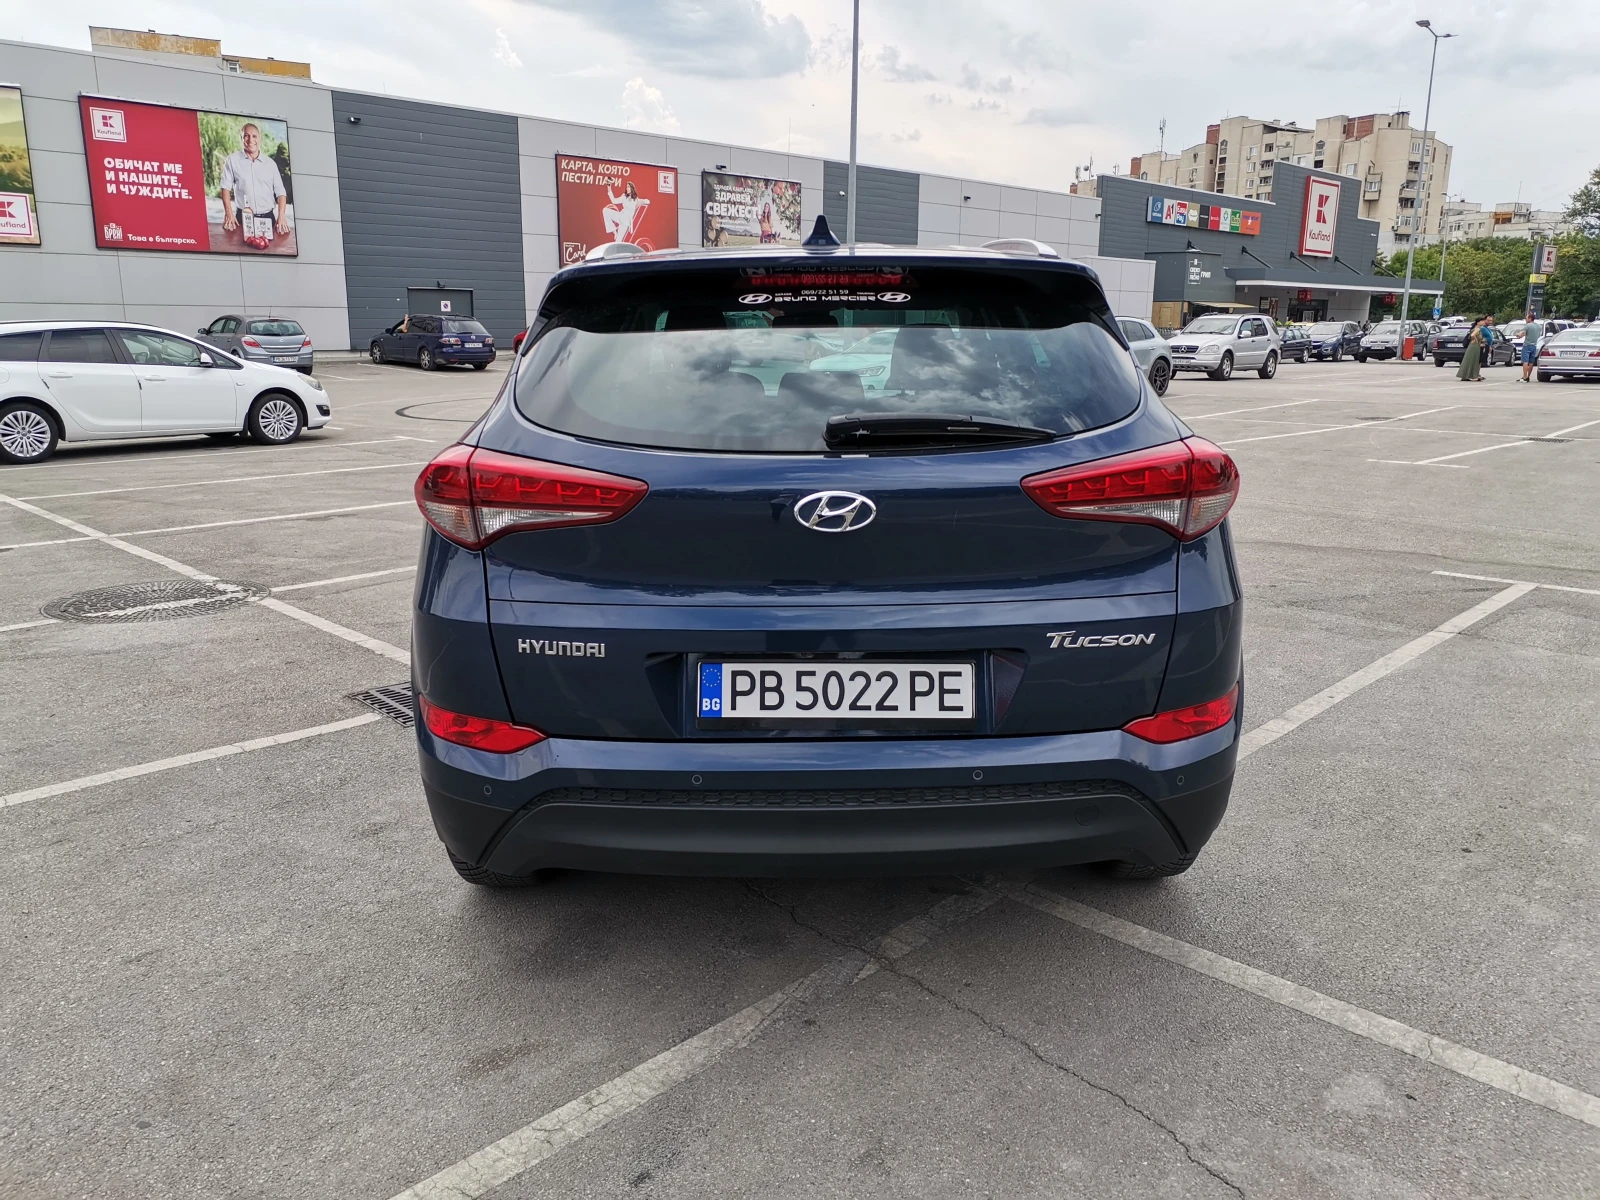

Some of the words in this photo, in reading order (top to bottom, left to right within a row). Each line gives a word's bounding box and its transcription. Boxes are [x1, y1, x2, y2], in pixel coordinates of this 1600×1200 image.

[104, 157, 160, 172] ОБИЧАТ
[163, 163, 183, 174] МЕ
[561, 159, 596, 174] КАРТА,
[598, 164, 630, 176] КОЯТО
[105, 170, 115, 181] И
[118, 171, 182, 188] НАШИТЕ,
[562, 171, 594, 184] ПЕСТИ
[106, 183, 117, 194] И
[119, 184, 193, 199] ЧУЖДИТЕ.
[1165, 203, 1174, 219] A1
[127, 234, 146, 242] Това
[155, 235, 197, 244] българско.
[1309, 229, 1331, 242] Kaufland
[566, 244, 586, 261] Card
[517, 638, 606, 658] HYUNDAI
[730, 669, 785, 711] PB
[795, 670, 899, 711] 5022
[909, 670, 964, 712] PE
[702, 698, 721, 711] BG
